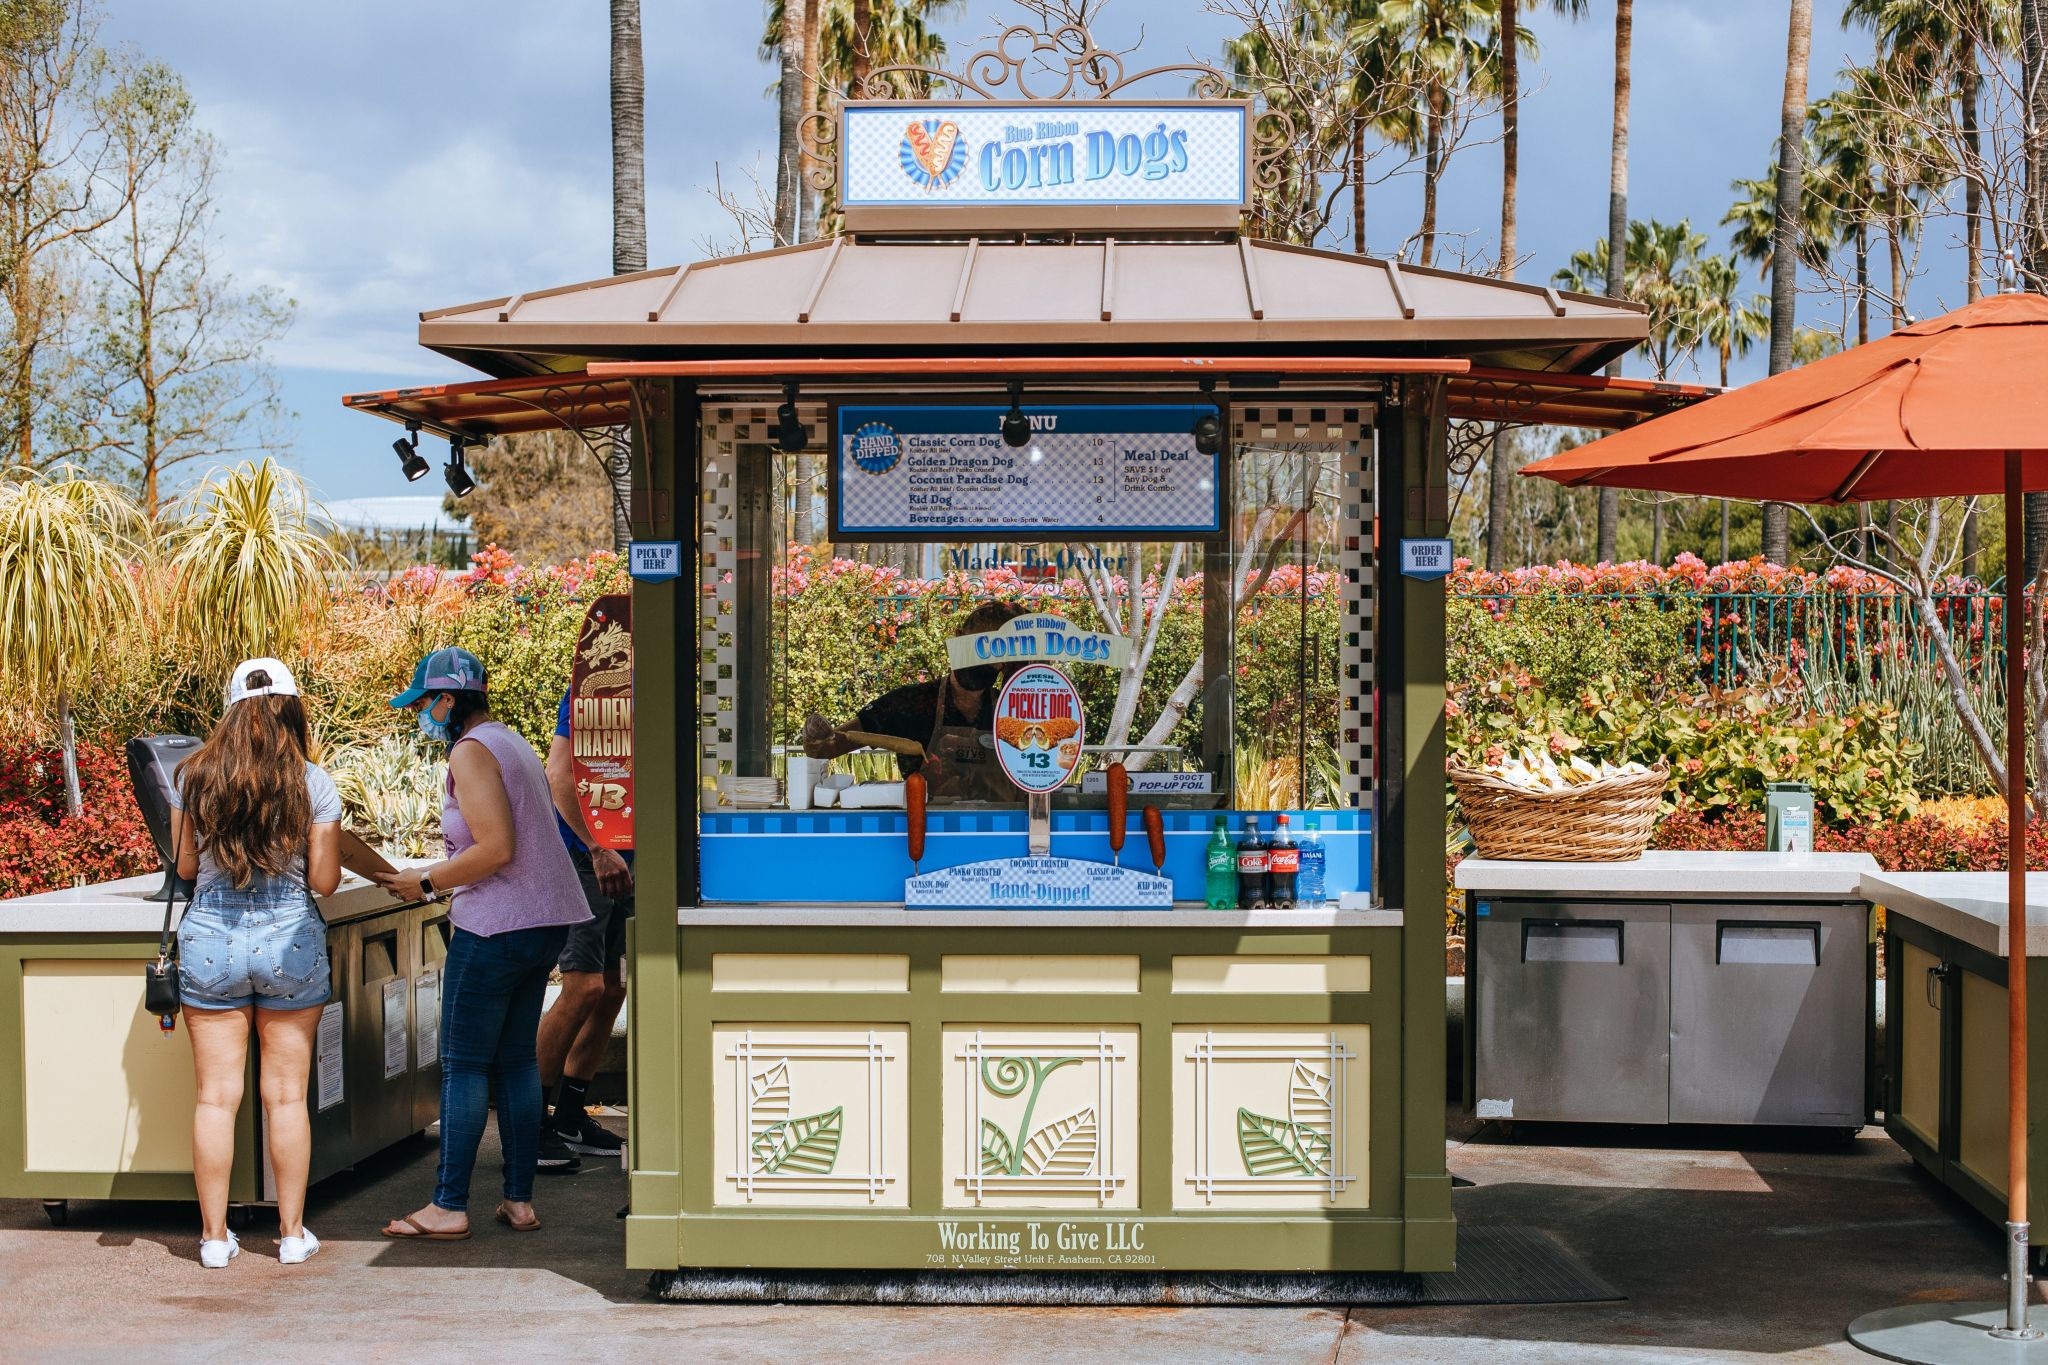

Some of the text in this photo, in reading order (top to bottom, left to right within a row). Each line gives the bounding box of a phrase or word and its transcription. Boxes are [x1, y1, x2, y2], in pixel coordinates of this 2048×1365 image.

[1004, 120, 1079, 144] Blue Ribbon
[979, 122, 1189, 192] Corn Dogs
[856, 435, 899, 460] HAND DIPPED
[909, 437, 946, 447] Classic
[950, 437, 976, 447] Corn
[979, 437, 1002, 449] Dog
[1124, 450, 1189, 461] Meal Deal
[908, 457, 1104, 468] Golden Dragon Dog 13
[909, 475, 954, 484] Coconut
[957, 474, 1004, 484] Paradise
[1007, 475, 1029, 487] Dog
[1124, 475, 1140, 483] Any
[1143, 475, 1158, 484] Dog
[909, 495, 927, 504] Kid
[931, 495, 953, 507] Dog
[909, 514, 964, 525] Beverages
[636, 548, 672, 559] PICK UP
[1411, 546, 1442, 555] ORDER
[643, 559, 666, 569] HERE
[950, 548, 1127, 570] Made To Order
[1415, 557, 1438, 566] HERE
[1014, 618, 1067, 631] Blue Ribbon
[975, 632, 1111, 661] Corn Dogs
[1008, 693, 1072, 719] PICKLE DOG
[573, 698, 631, 730] GOLDEN
[574, 730, 631, 757] DRAGON
[1021, 753, 1050, 768] $13
[1139, 782, 1204, 790] POP-UP FOIL
[577, 778, 628, 810] $13
[1010, 860, 1069, 868] COCONUT CRUSTED
[1241, 857, 1263, 866] Coke
[949, 868, 1001, 877] PANKO CRUSTED
[1087, 868, 1125, 876] CLASSIC DOG
[911, 880, 949, 889] CLASSIC DOG
[1137, 881, 1168, 890] KID DOG
[937, 1222, 1145, 1254] Working To Give LLC
[926, 1254, 945, 1263] 708
[962, 1254, 991, 1265] Valley
[994, 1254, 1021, 1263] Street
[1025, 1254, 1045, 1263] Unit
[1047, 1254, 1055, 1264] F,
[1059, 1254, 1105, 1264] Anaheim,
[1108, 1254, 1122, 1263] CA
[1124, 1254, 1156, 1264] 92801
